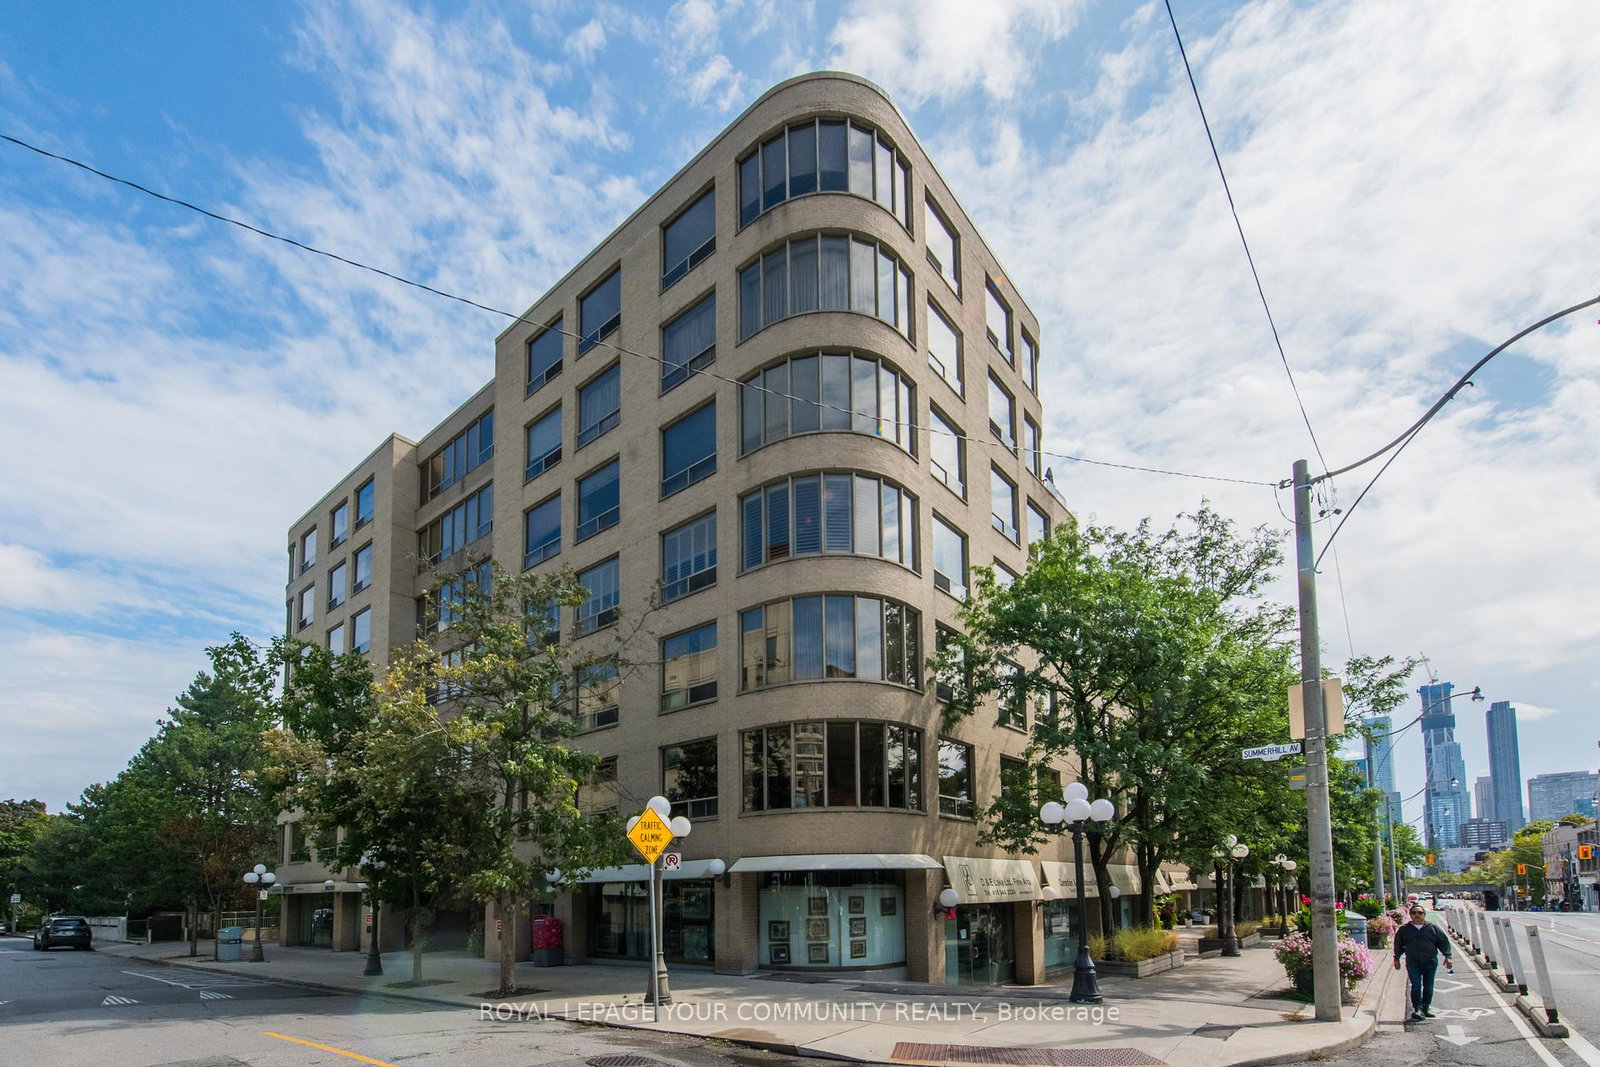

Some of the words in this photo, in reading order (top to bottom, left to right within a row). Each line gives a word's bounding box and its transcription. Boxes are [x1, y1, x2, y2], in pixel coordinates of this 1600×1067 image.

[1244, 746, 1287, 758] SUMMERHILL
[640, 821, 661, 831] TRAFFIC
[640, 833, 663, 843] CALMING
[645, 845, 658, 854] ZONE
